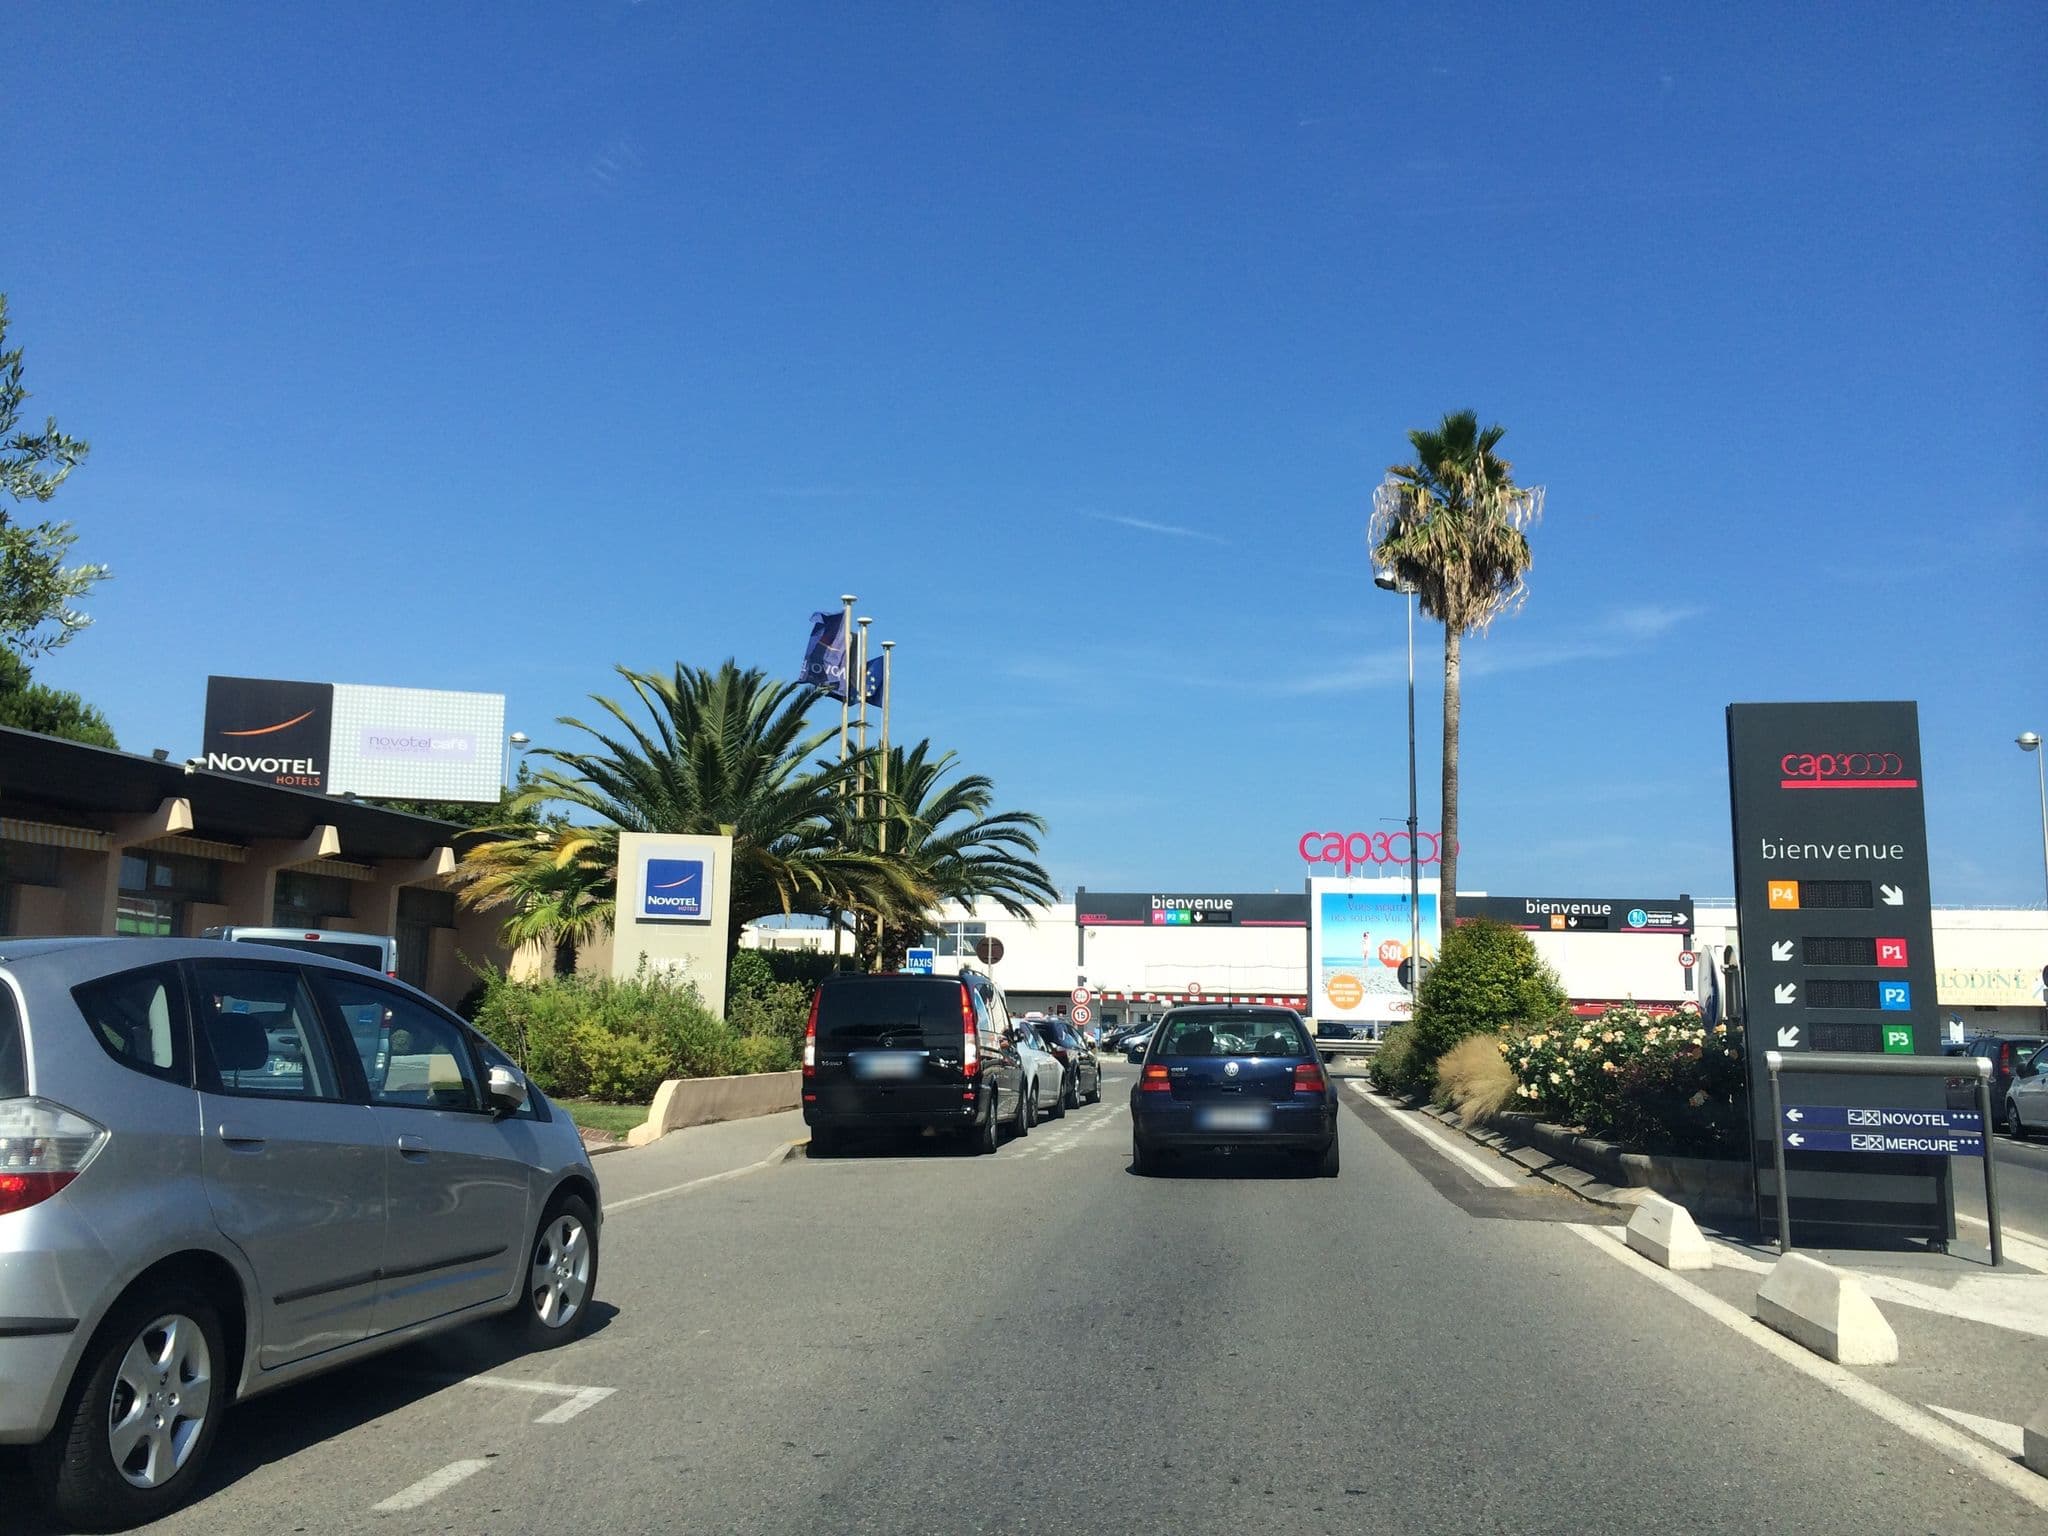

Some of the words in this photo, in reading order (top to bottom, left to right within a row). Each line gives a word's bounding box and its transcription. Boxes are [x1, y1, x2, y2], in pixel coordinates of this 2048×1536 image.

[208, 752, 321, 776] NOVOTEL
[1780, 752, 1903, 782] cap3000
[276, 775, 320, 786] HOTELS
[1298, 831, 1460, 875] cap300
[1762, 837, 1904, 860] bienvenue
[648, 895, 698, 906] NOVOTEL
[1772, 888, 1793, 901] P4
[1151, 895, 1233, 909] bienvenue
[1525, 899, 1612, 915] bienvenue
[1154, 913, 1164, 921] P1
[1167, 913, 1176, 921] P2
[1882, 946, 1902, 959] P1
[908, 957, 933, 968] TAXIS
[1885, 988, 1905, 1002] P2
[1076, 1011, 1085, 1019] 15
[1888, 1032, 1909, 1046] P3
[1882, 1112, 1950, 1127] NOVOTEL
[1886, 1137, 1958, 1152] MERCURE
